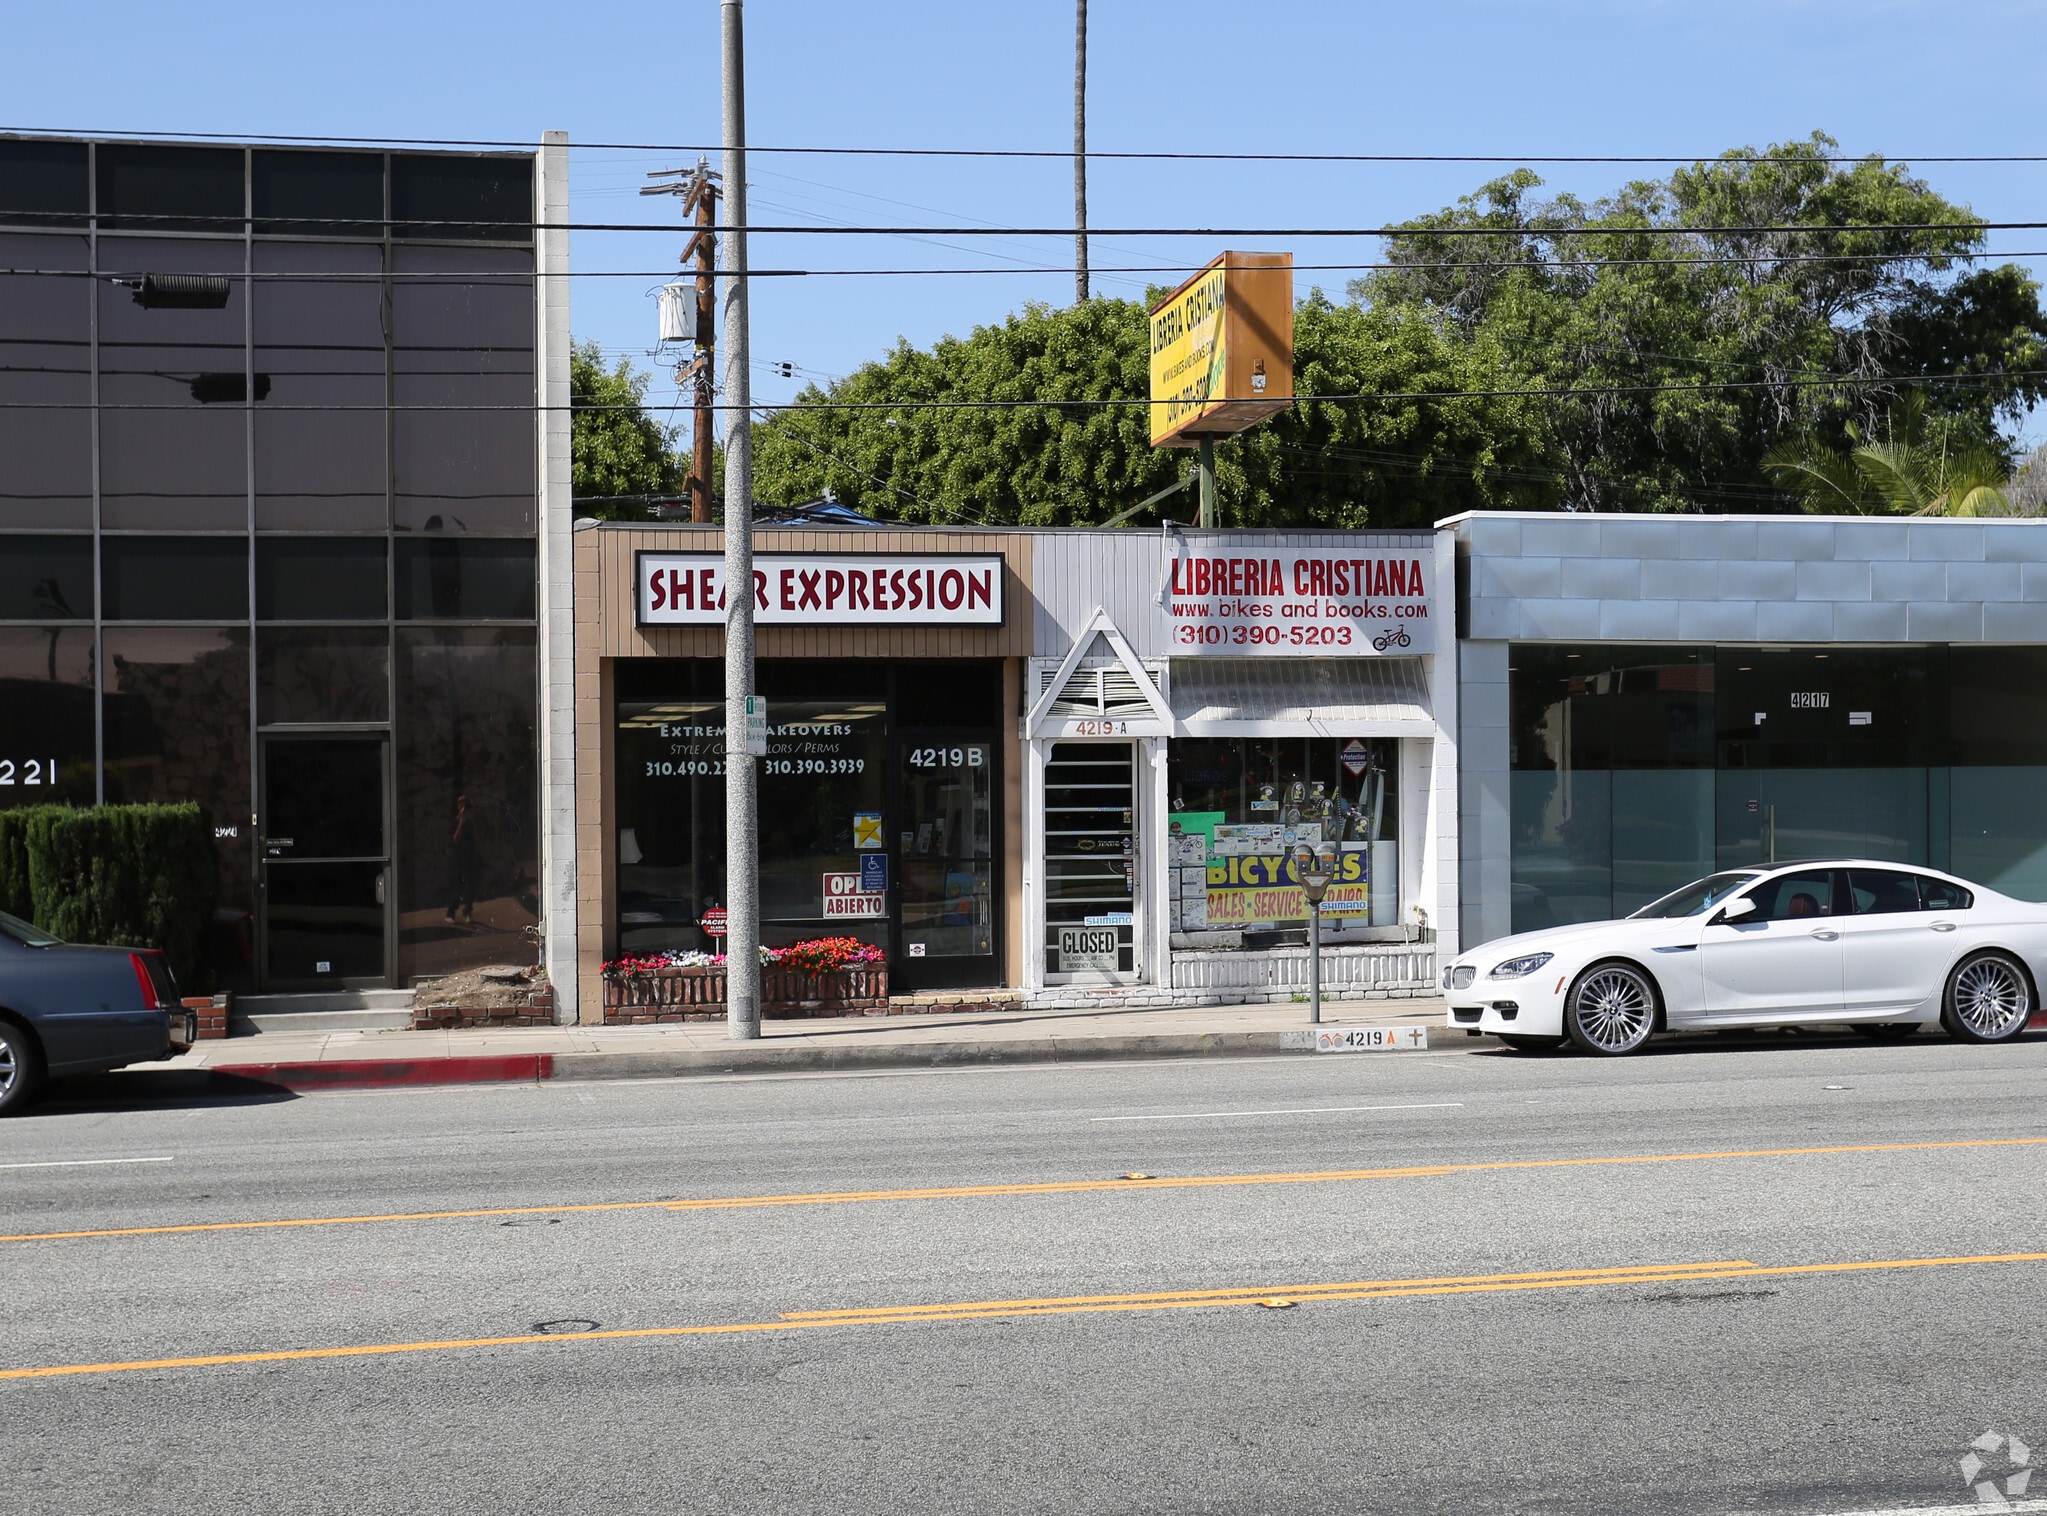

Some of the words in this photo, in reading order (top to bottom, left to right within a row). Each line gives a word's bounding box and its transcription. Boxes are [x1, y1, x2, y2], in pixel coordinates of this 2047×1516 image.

[1153, 304, 1184, 355] LIBRERIA
[1186, 272, 1225, 332] CRISTIANA
[1171, 558, 1284, 596] LIBRERIA
[1293, 559, 1424, 596] CRISTIANA
[780, 568, 991, 611] EXPRESSION
[1281, 599, 1318, 618] and
[1791, 692, 1829, 707] 4217
[660, 724, 727, 738] EXTREM
[765, 724, 852, 736] AKEOVERS
[670, 743, 701, 755] STYLE
[767, 743, 793, 754] LORS
[804, 742, 840, 754] PERMS
[646, 761, 727, 776] 310.490.2
[765, 758, 865, 775] 310.390.3939
[827, 898, 882, 914] ABIERTO
[1207, 893, 1245, 919] SALES
[1254, 890, 1302, 918] SERVICE
[1321, 902, 1366, 910] SHIMANO
[1062, 931, 1115, 954] CLOSED
[1345, 1031, 1382, 1046] 4219
